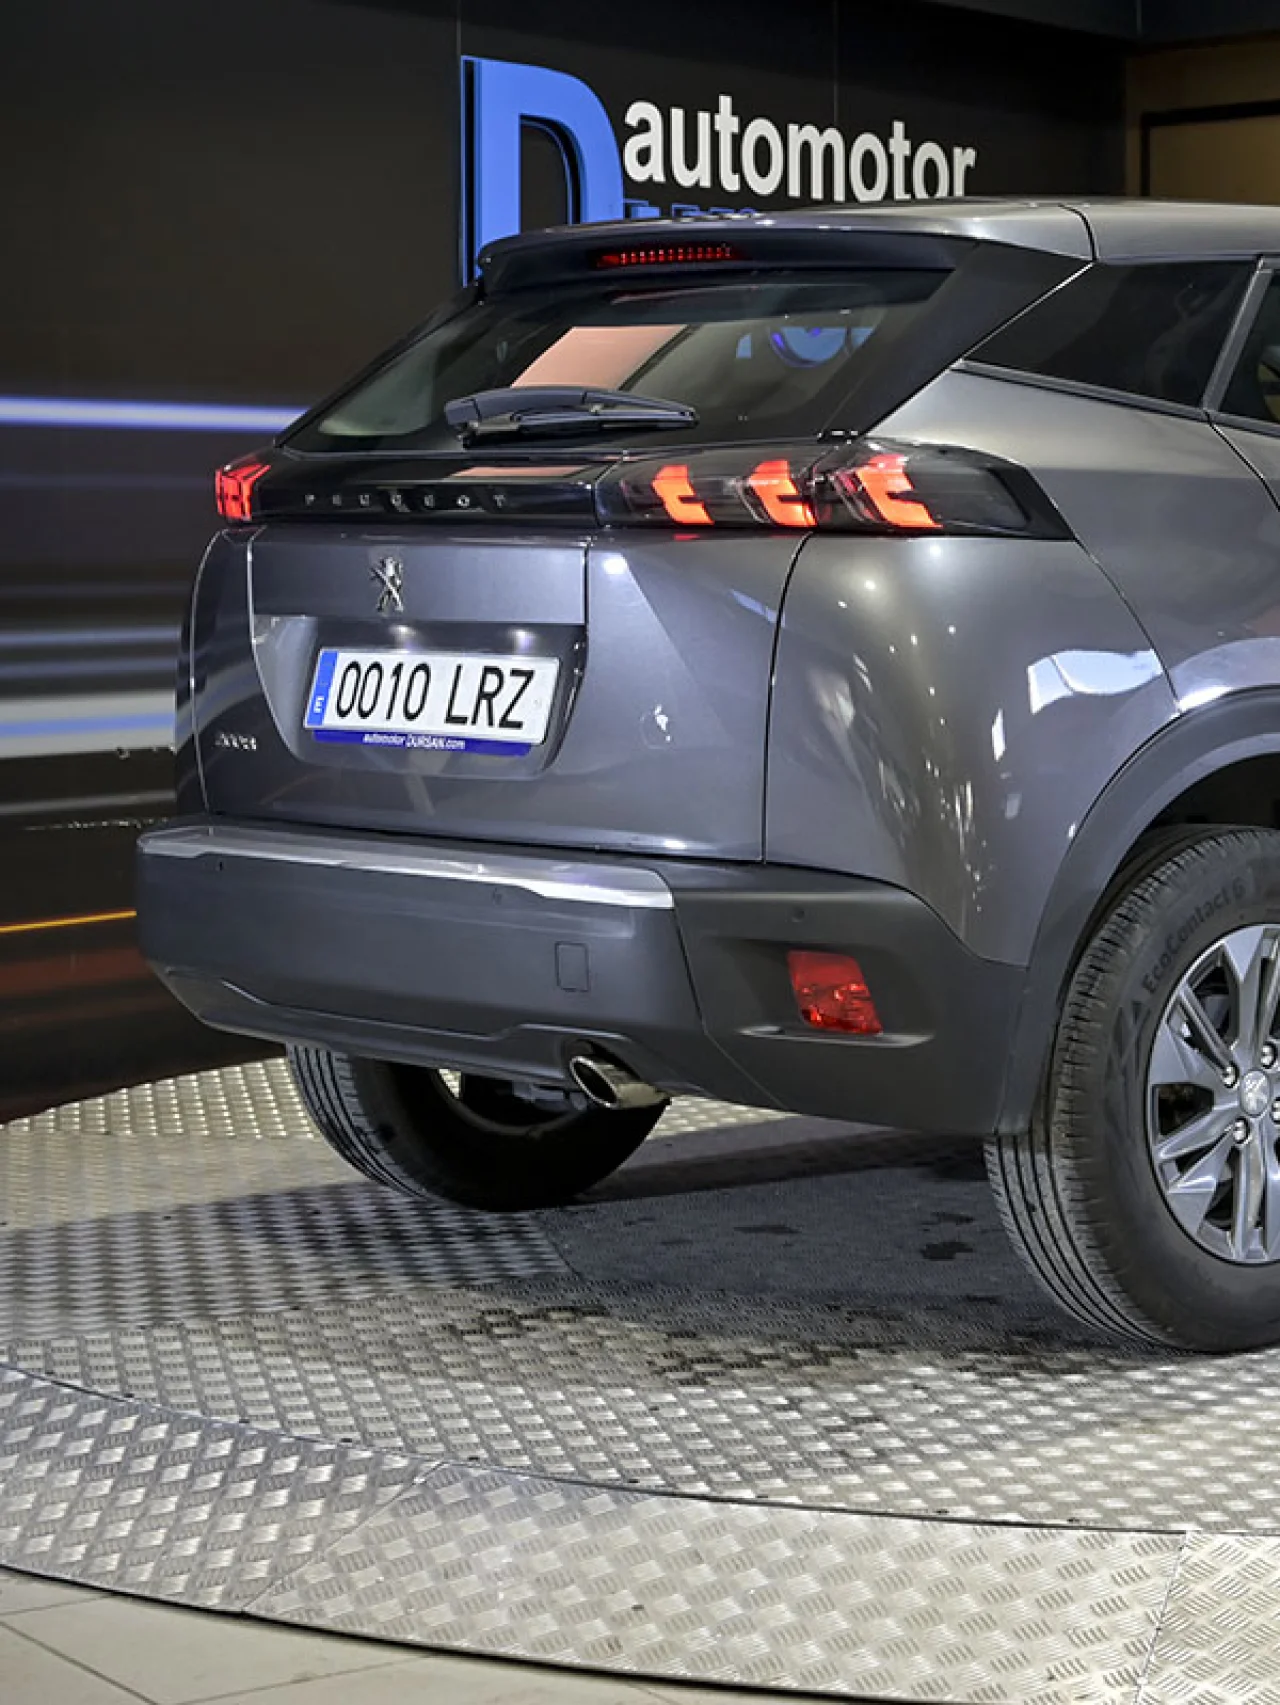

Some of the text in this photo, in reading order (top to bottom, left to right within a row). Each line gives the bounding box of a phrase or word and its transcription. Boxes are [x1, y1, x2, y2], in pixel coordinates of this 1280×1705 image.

[624, 95, 977, 202] automotor
[313, 695, 325, 714] E
[335, 660, 536, 730] 0010 LRZ
